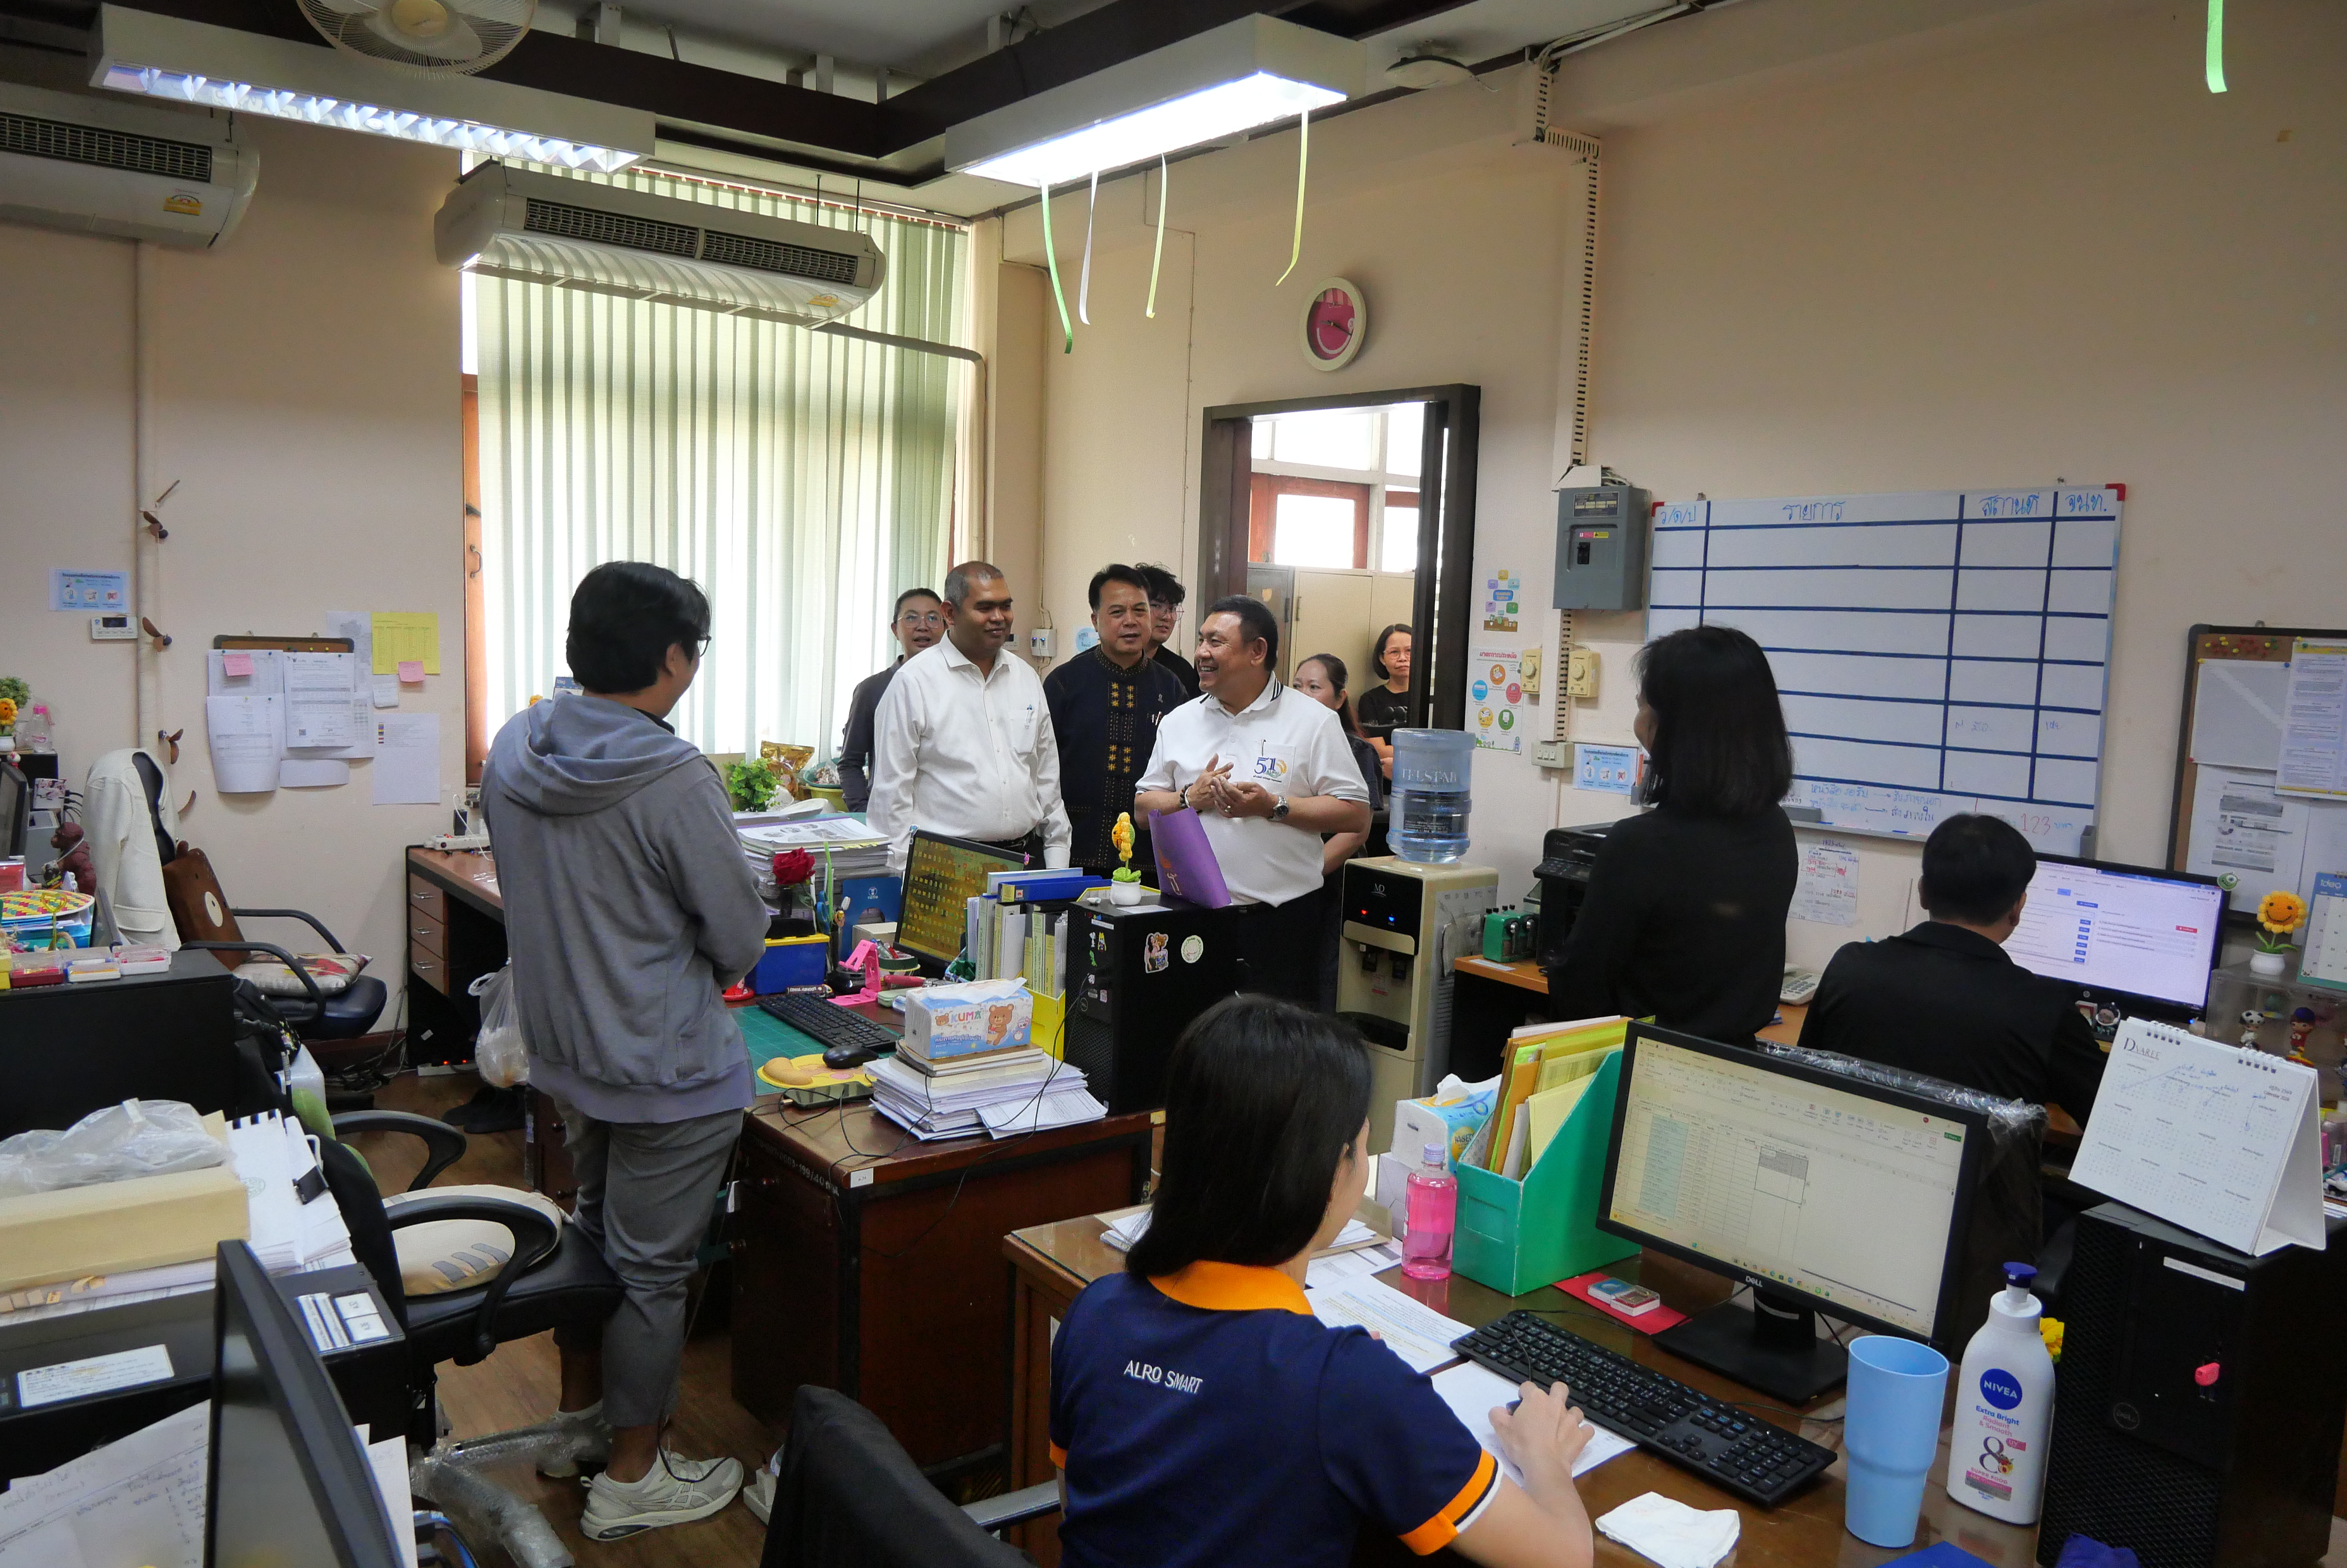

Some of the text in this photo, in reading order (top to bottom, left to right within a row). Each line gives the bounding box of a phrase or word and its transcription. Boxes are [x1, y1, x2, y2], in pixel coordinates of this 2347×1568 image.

[1782, 500, 1846, 522] รายการ
[1254, 757, 1276, 775] 51
[2020, 813, 2051, 835] 123
[950, 1010, 982, 1023] KUMA
[1746, 1275, 1763, 1287] DELL
[1124, 1359, 1203, 1394] ALRO SMART
[1983, 1380, 2018, 1399] NIVEA
[1975, 1405, 2020, 1426] Extra Bright
[1983, 1415, 2010, 1429] Radiant
[1985, 1423, 2013, 1437] Smooth
